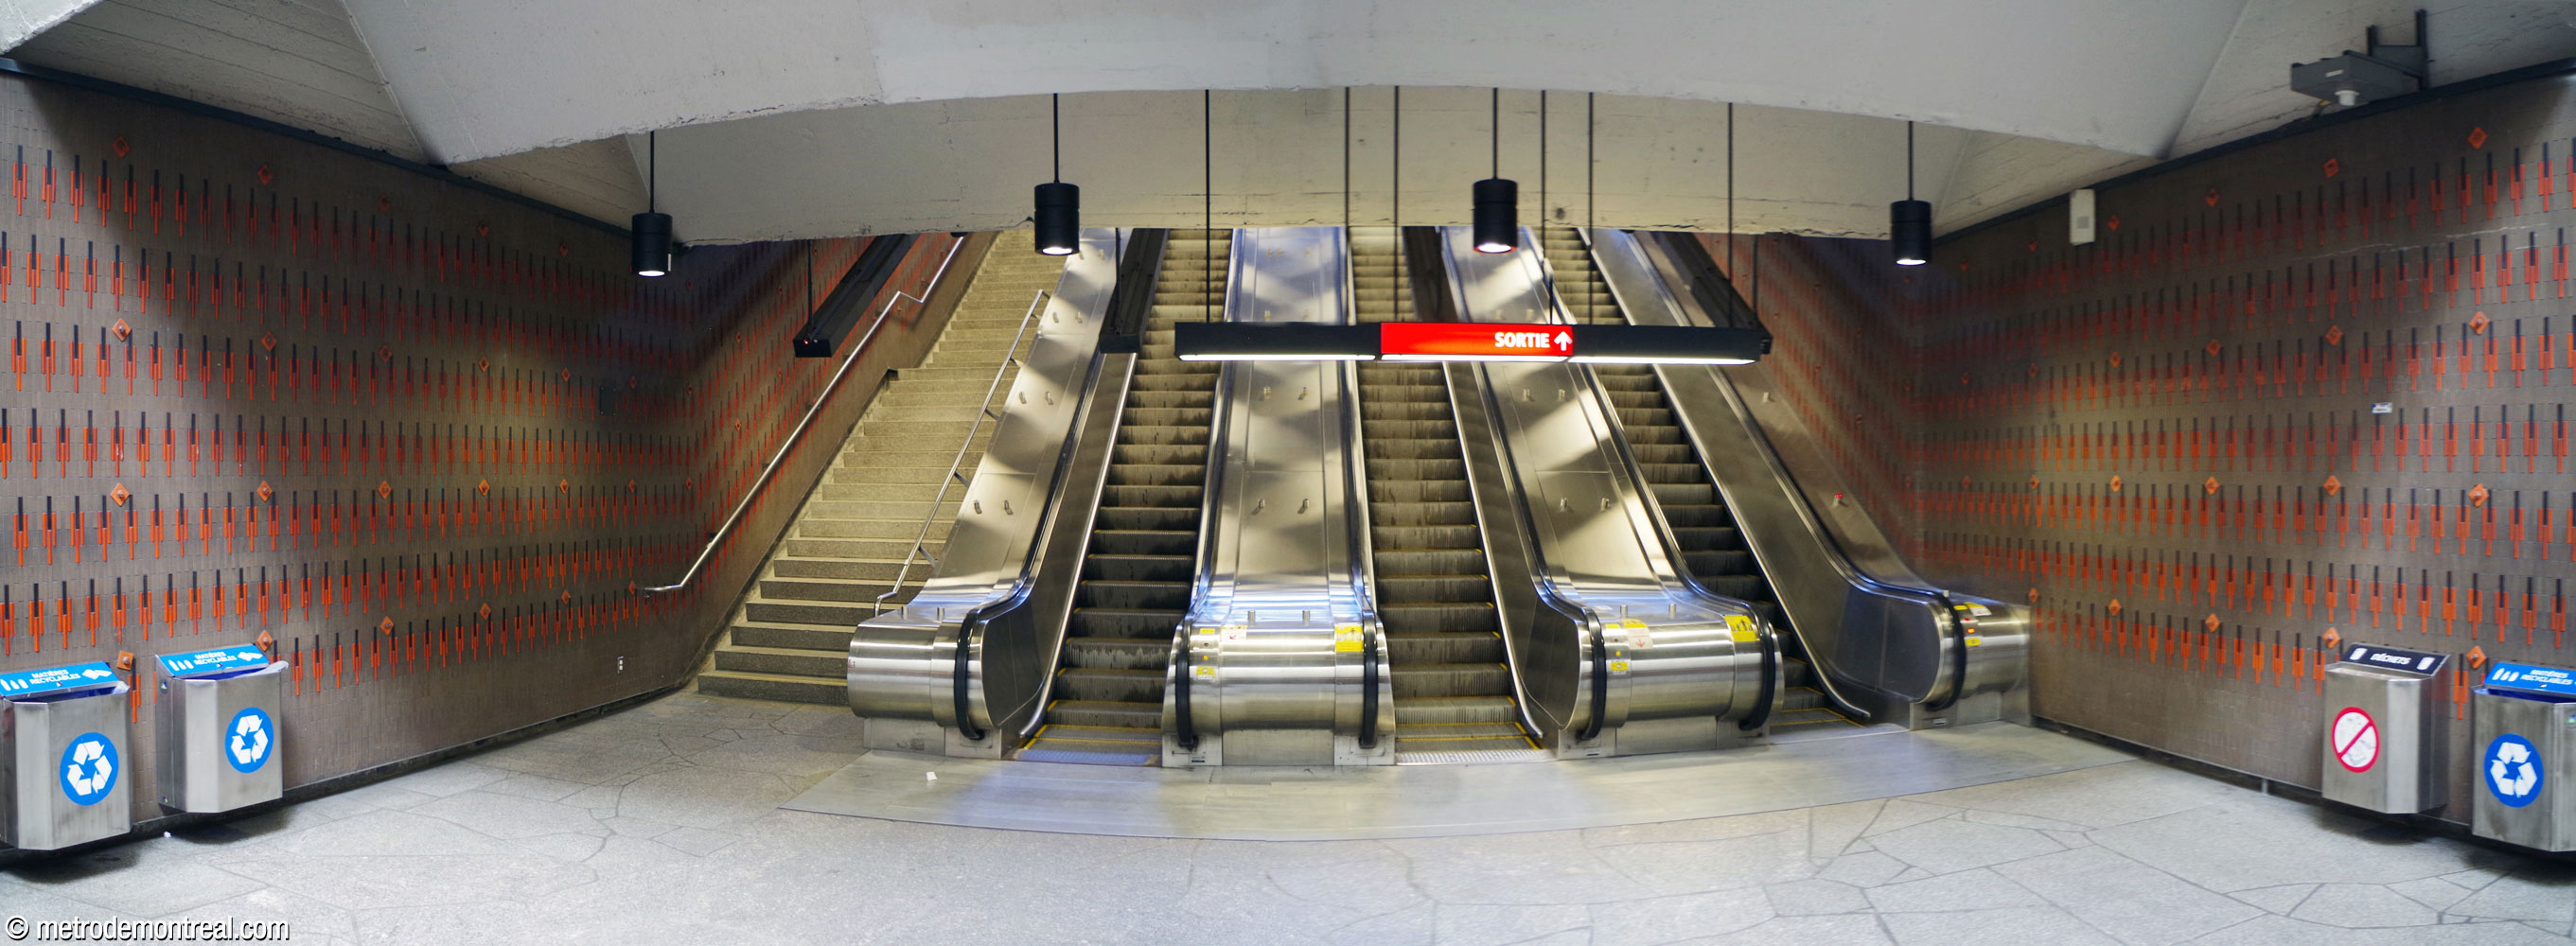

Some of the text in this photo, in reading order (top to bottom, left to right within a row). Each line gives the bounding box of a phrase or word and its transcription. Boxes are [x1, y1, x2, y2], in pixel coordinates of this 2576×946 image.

[1494, 332, 1550, 348] SORTIE
[193, 655, 238, 665] RECYCLABLES
[194, 651, 227, 660] MATIÈRES
[2369, 653, 2412, 665] DÉCHETS
[29, 673, 81, 685] RECYCLABLES
[31, 669, 69, 679] MATIÈRES
[2520, 674, 2573, 686] RECYCLABLES
